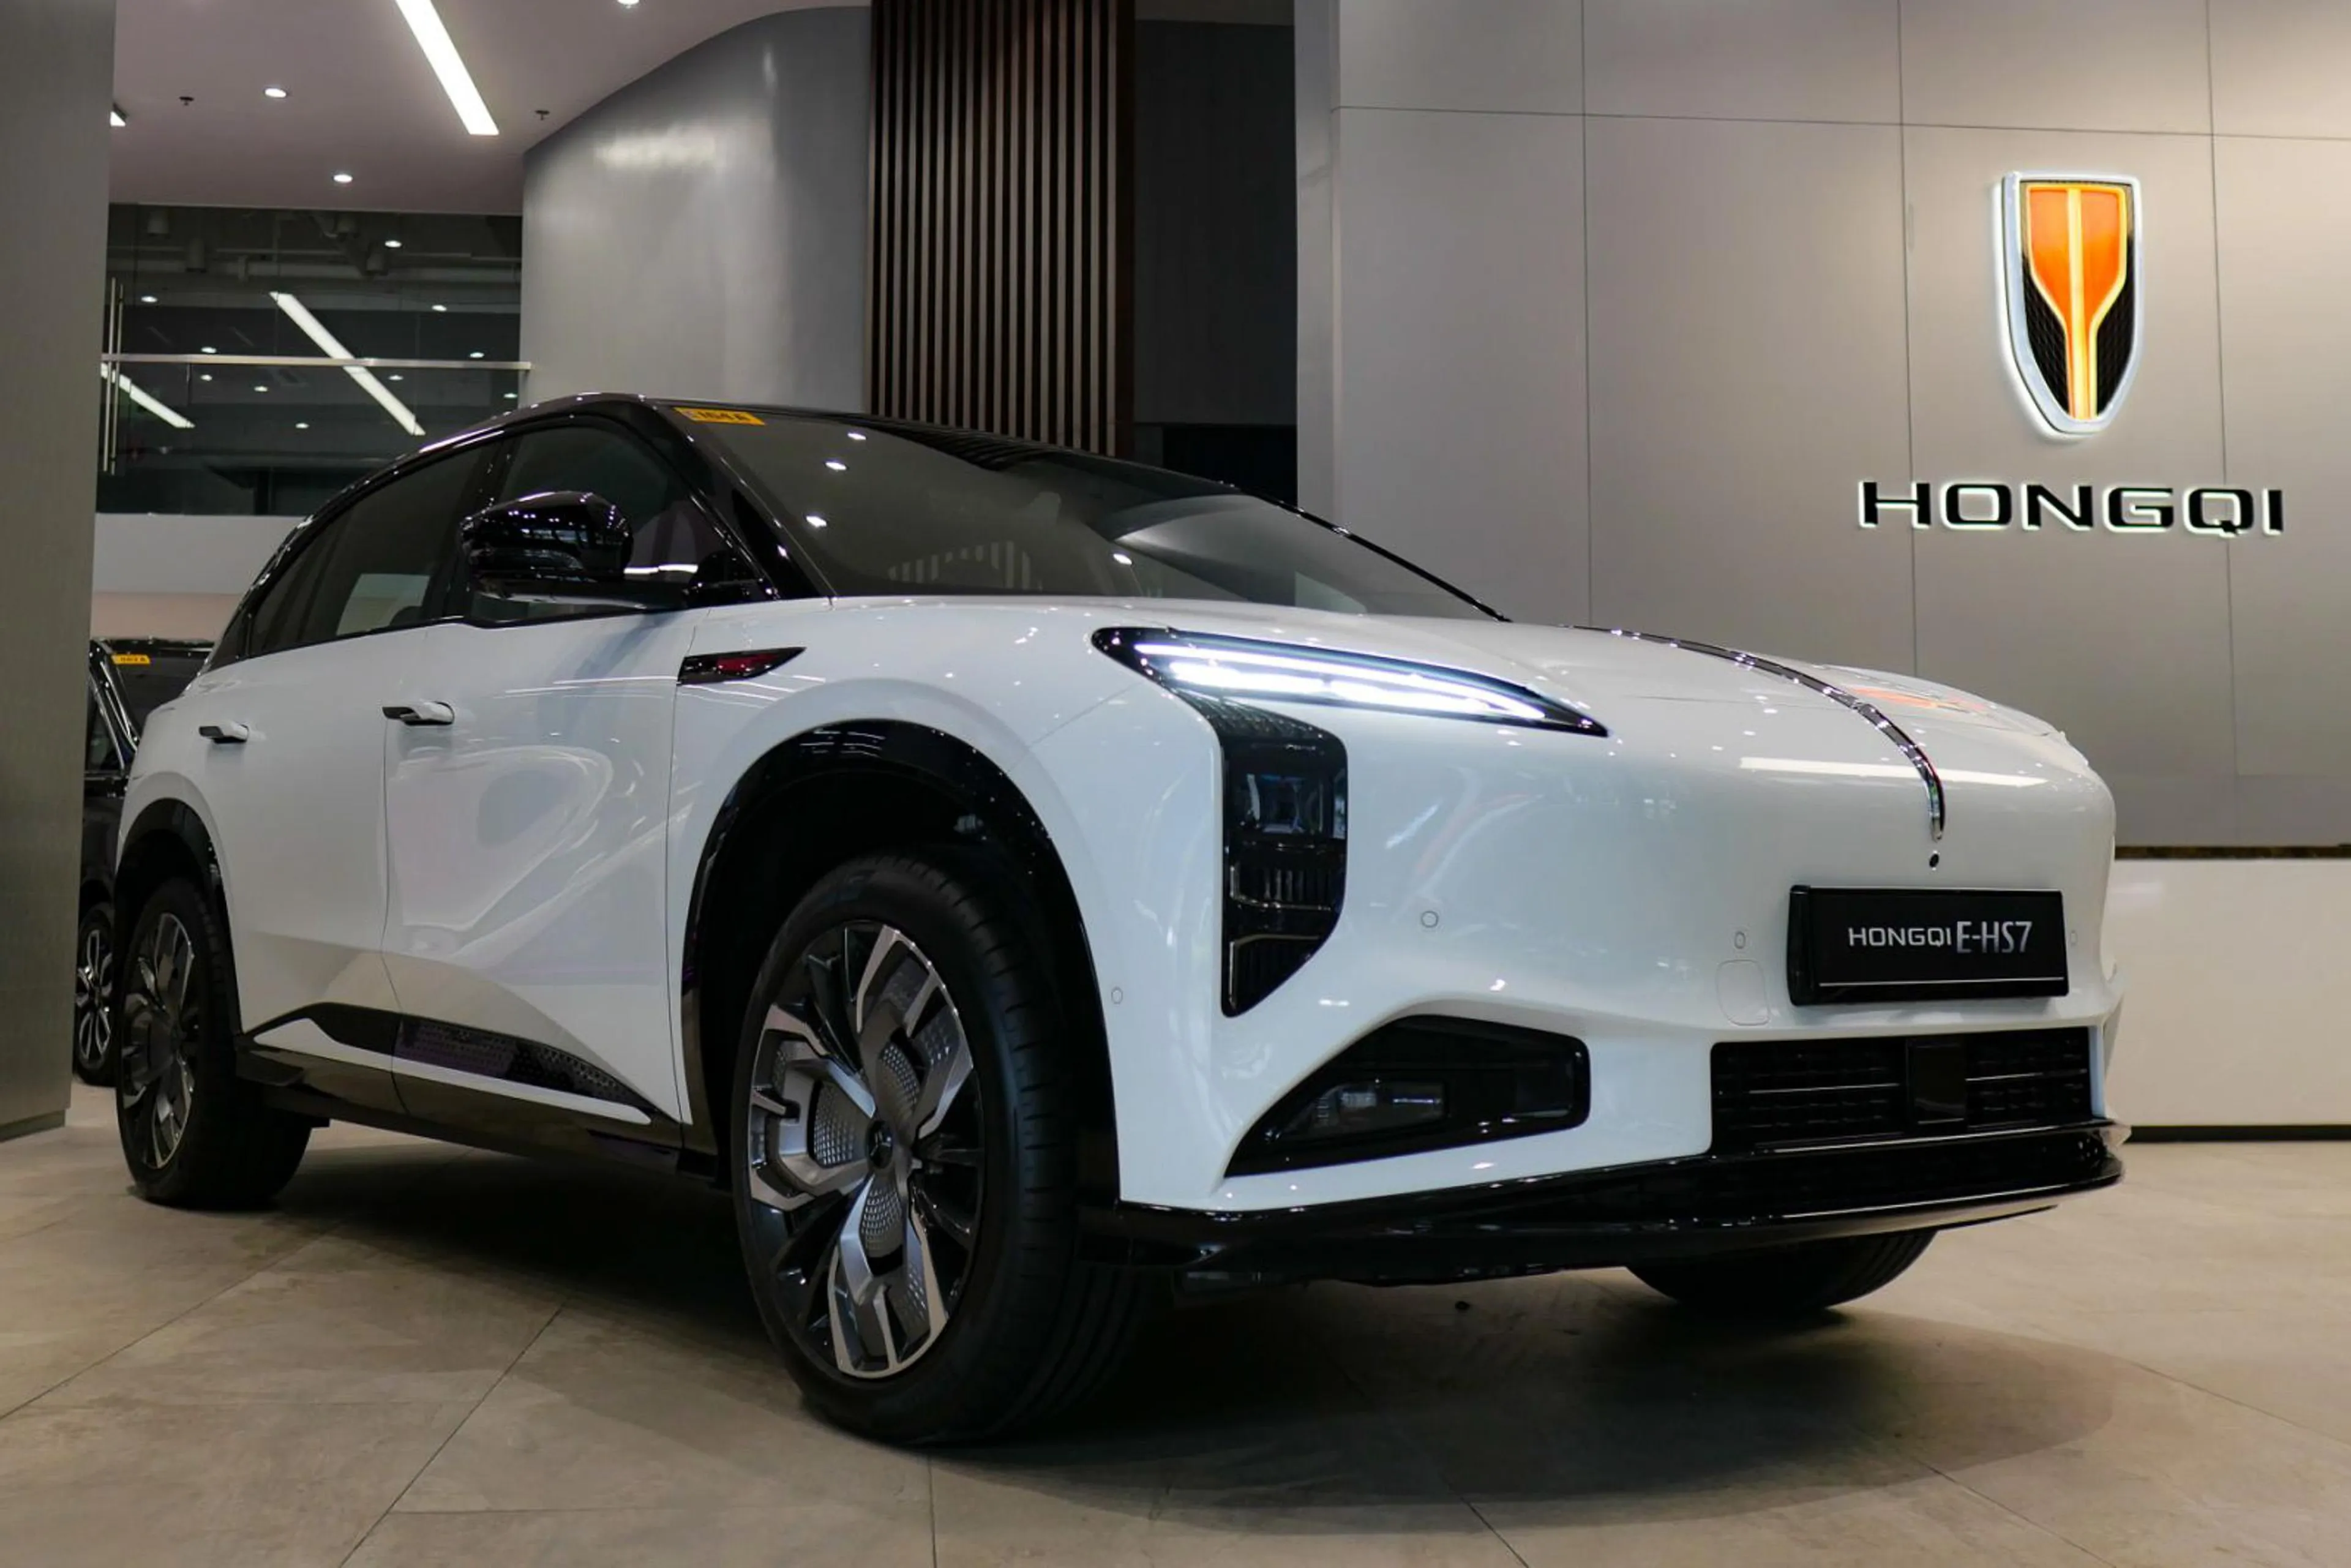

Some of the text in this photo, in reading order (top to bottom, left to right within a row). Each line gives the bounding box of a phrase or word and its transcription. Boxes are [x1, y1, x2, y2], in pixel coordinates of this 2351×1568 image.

[1859, 481, 2284, 536] HONGQI
[1848, 921, 2032, 953] HONGQI E-HS7
